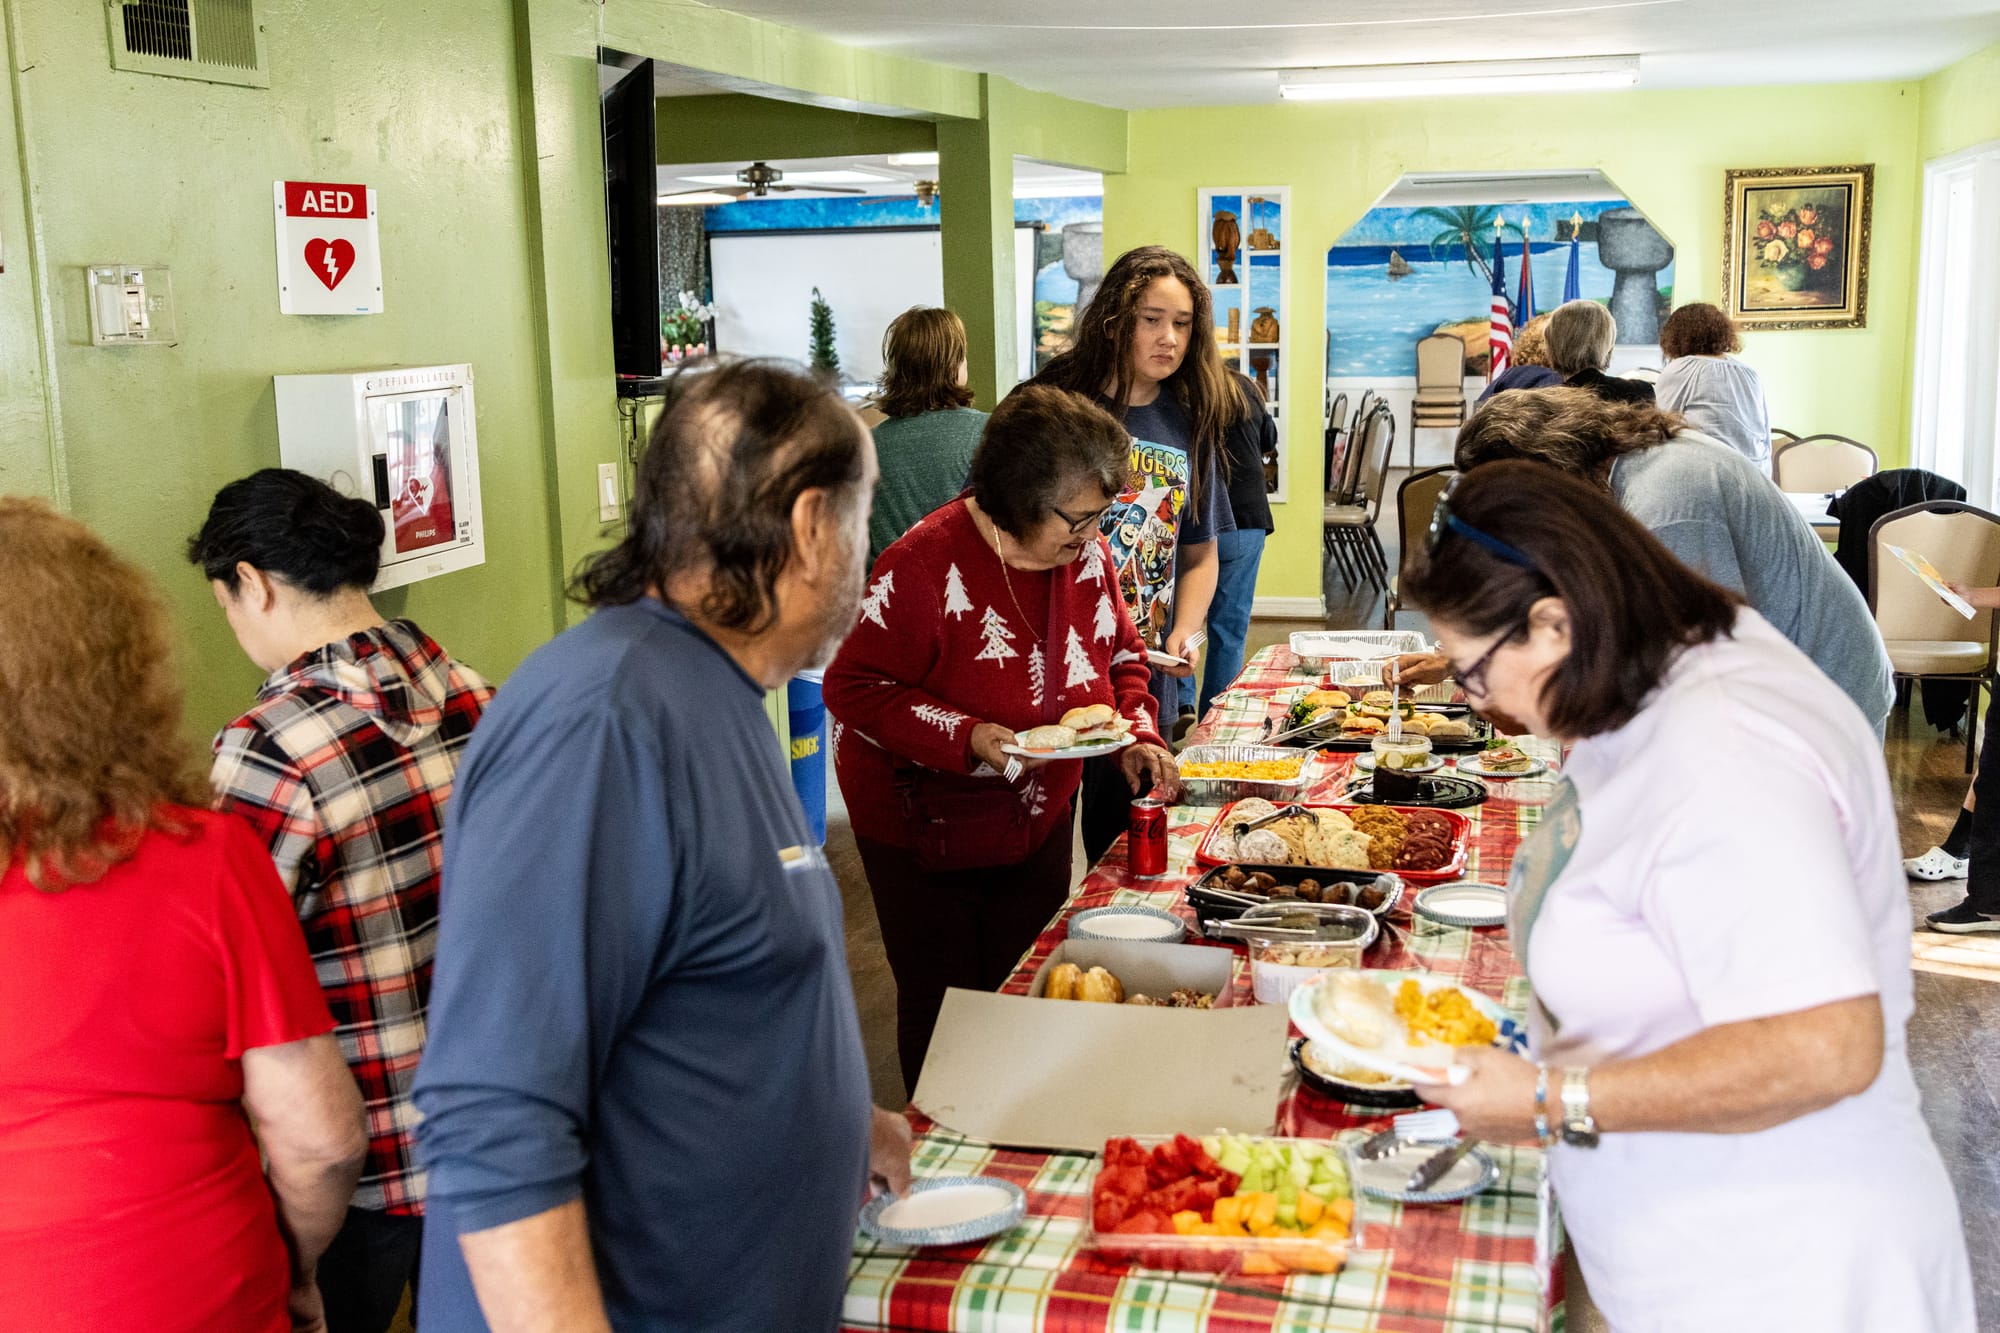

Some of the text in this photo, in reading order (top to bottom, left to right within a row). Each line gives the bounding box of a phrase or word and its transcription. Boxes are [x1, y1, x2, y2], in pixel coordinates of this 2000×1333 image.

[301, 190, 354, 213] AED
[1128, 444, 1187, 481] NGERS
[415, 529, 436, 539] PHILIPS
